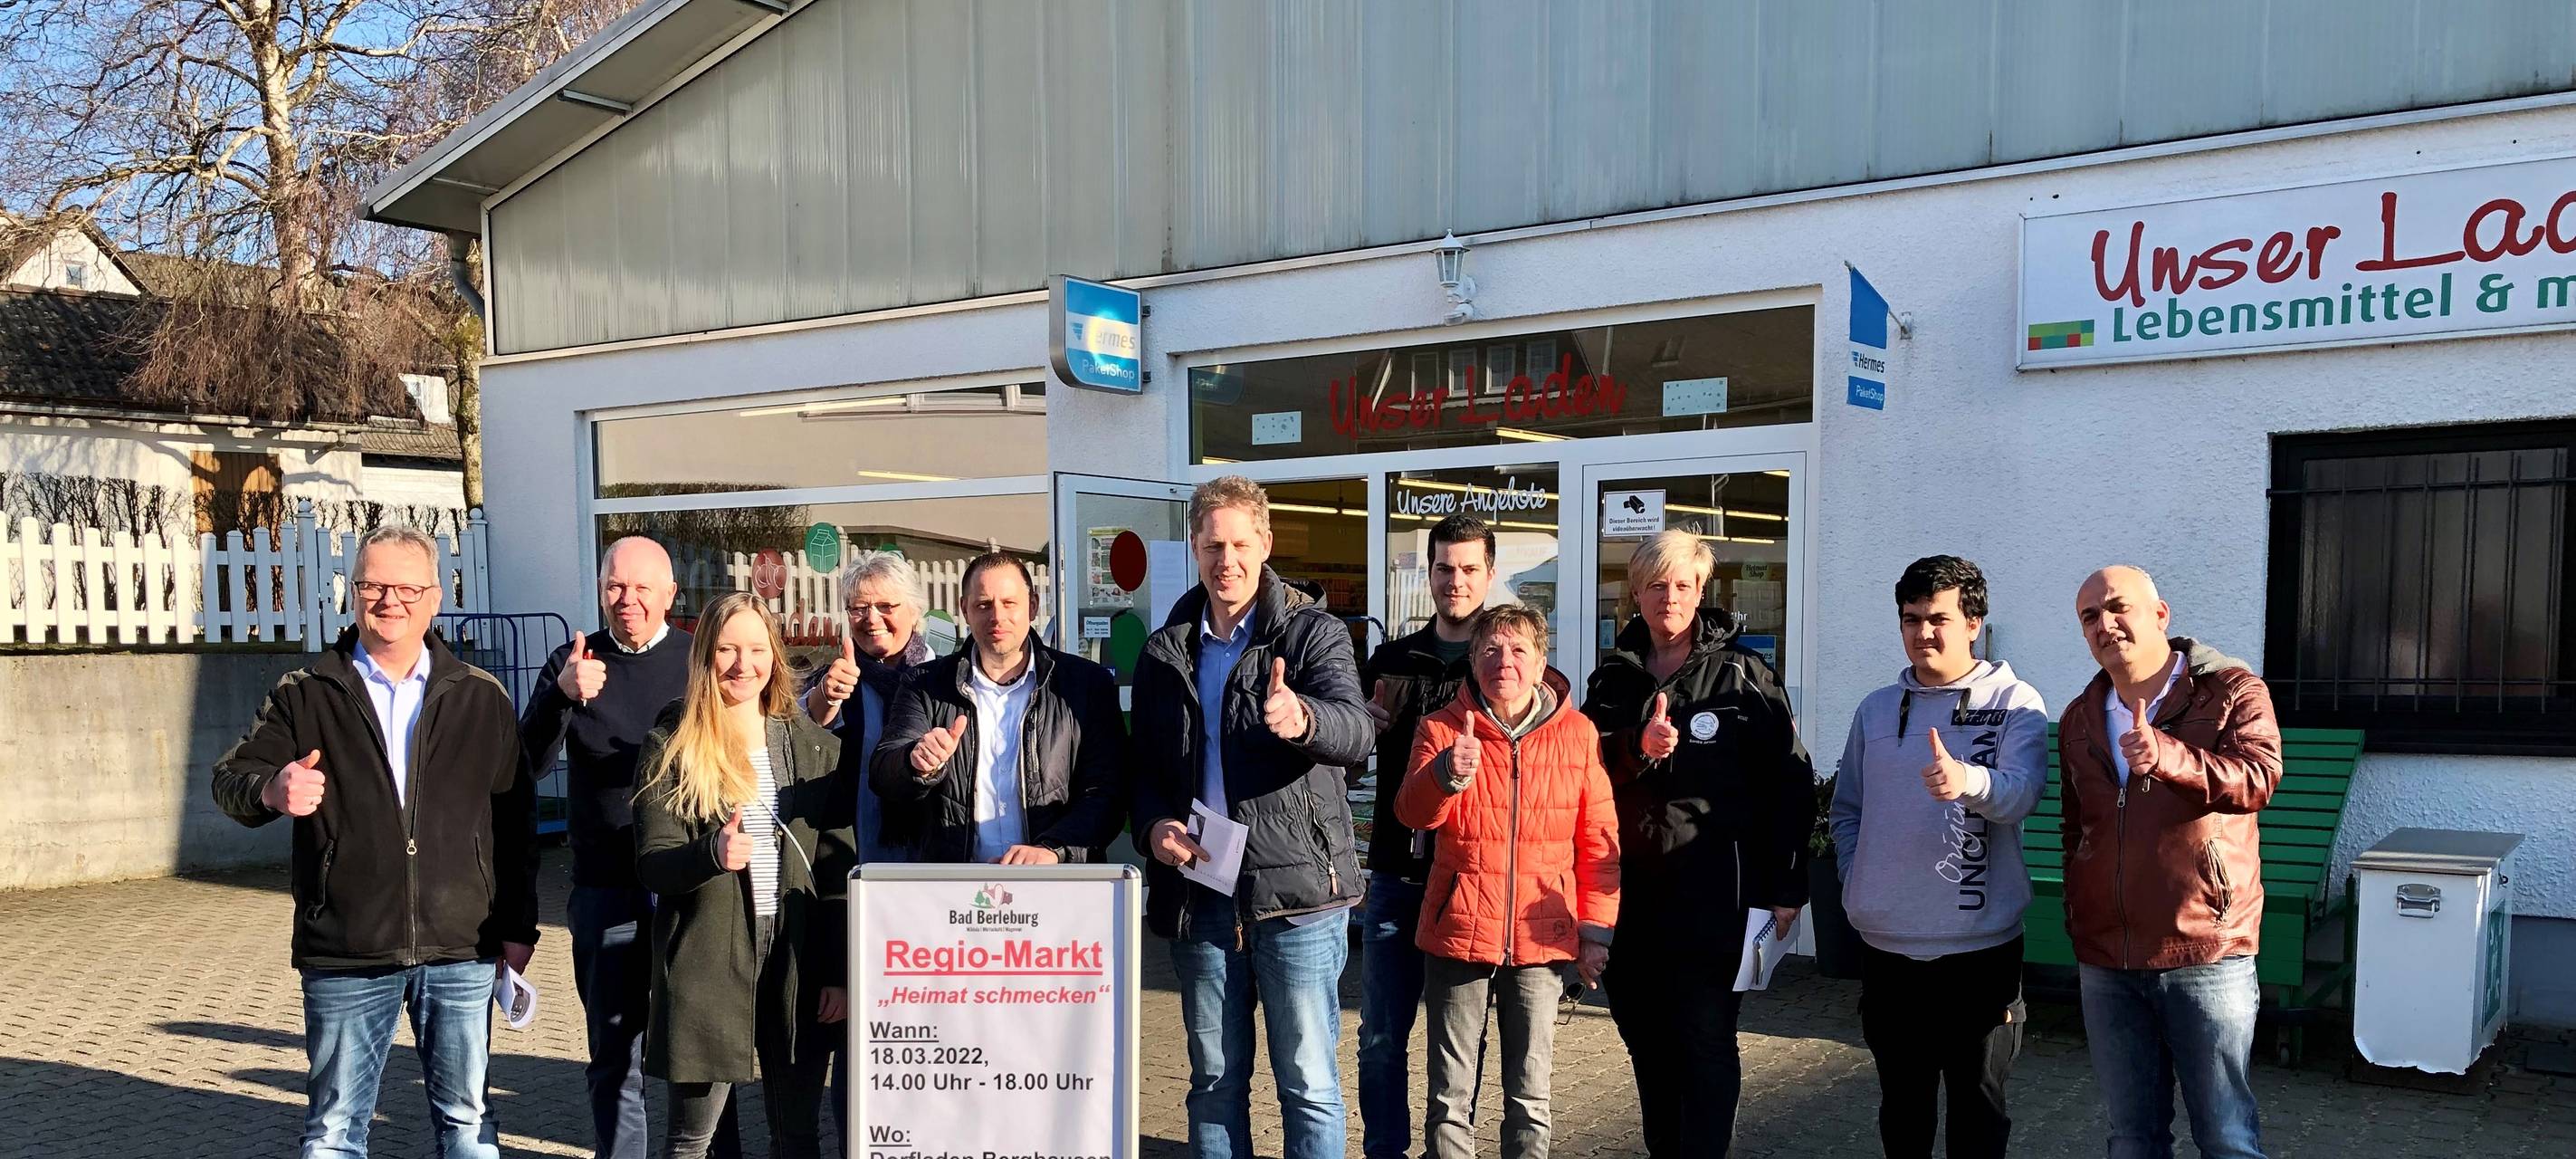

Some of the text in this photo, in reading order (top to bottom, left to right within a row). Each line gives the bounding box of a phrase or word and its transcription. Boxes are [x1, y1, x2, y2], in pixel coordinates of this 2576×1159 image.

[2091, 220, 2342, 308] Unser
[2113, 273, 2453, 342] Lebensmittel
[2476, 273, 2514, 313] &
[1092, 328, 1136, 350] ermes
[1082, 359, 1135, 382] PaketShop
[1858, 352, 1885, 374] Hermes
[1328, 351, 1627, 440] Unser Laden
[1856, 384, 1884, 404] PaketShop
[1397, 475, 1548, 522] Unsere Angebote
[771, 598, 841, 647] aden
[949, 910, 1039, 927] Bad Berleburg
[884, 940, 1103, 973] Regio-Markt
[870, 1021, 939, 1039] Wann:
[870, 1048, 988, 1067] 18.03.2022,
[870, 1074, 925, 1090] 14.00
[933, 1073, 972, 1090] Uhr
[993, 1073, 1048, 1090] 18.00
[1055, 1073, 1093, 1090] Uhr
[869, 1125, 911, 1144] Wo:
